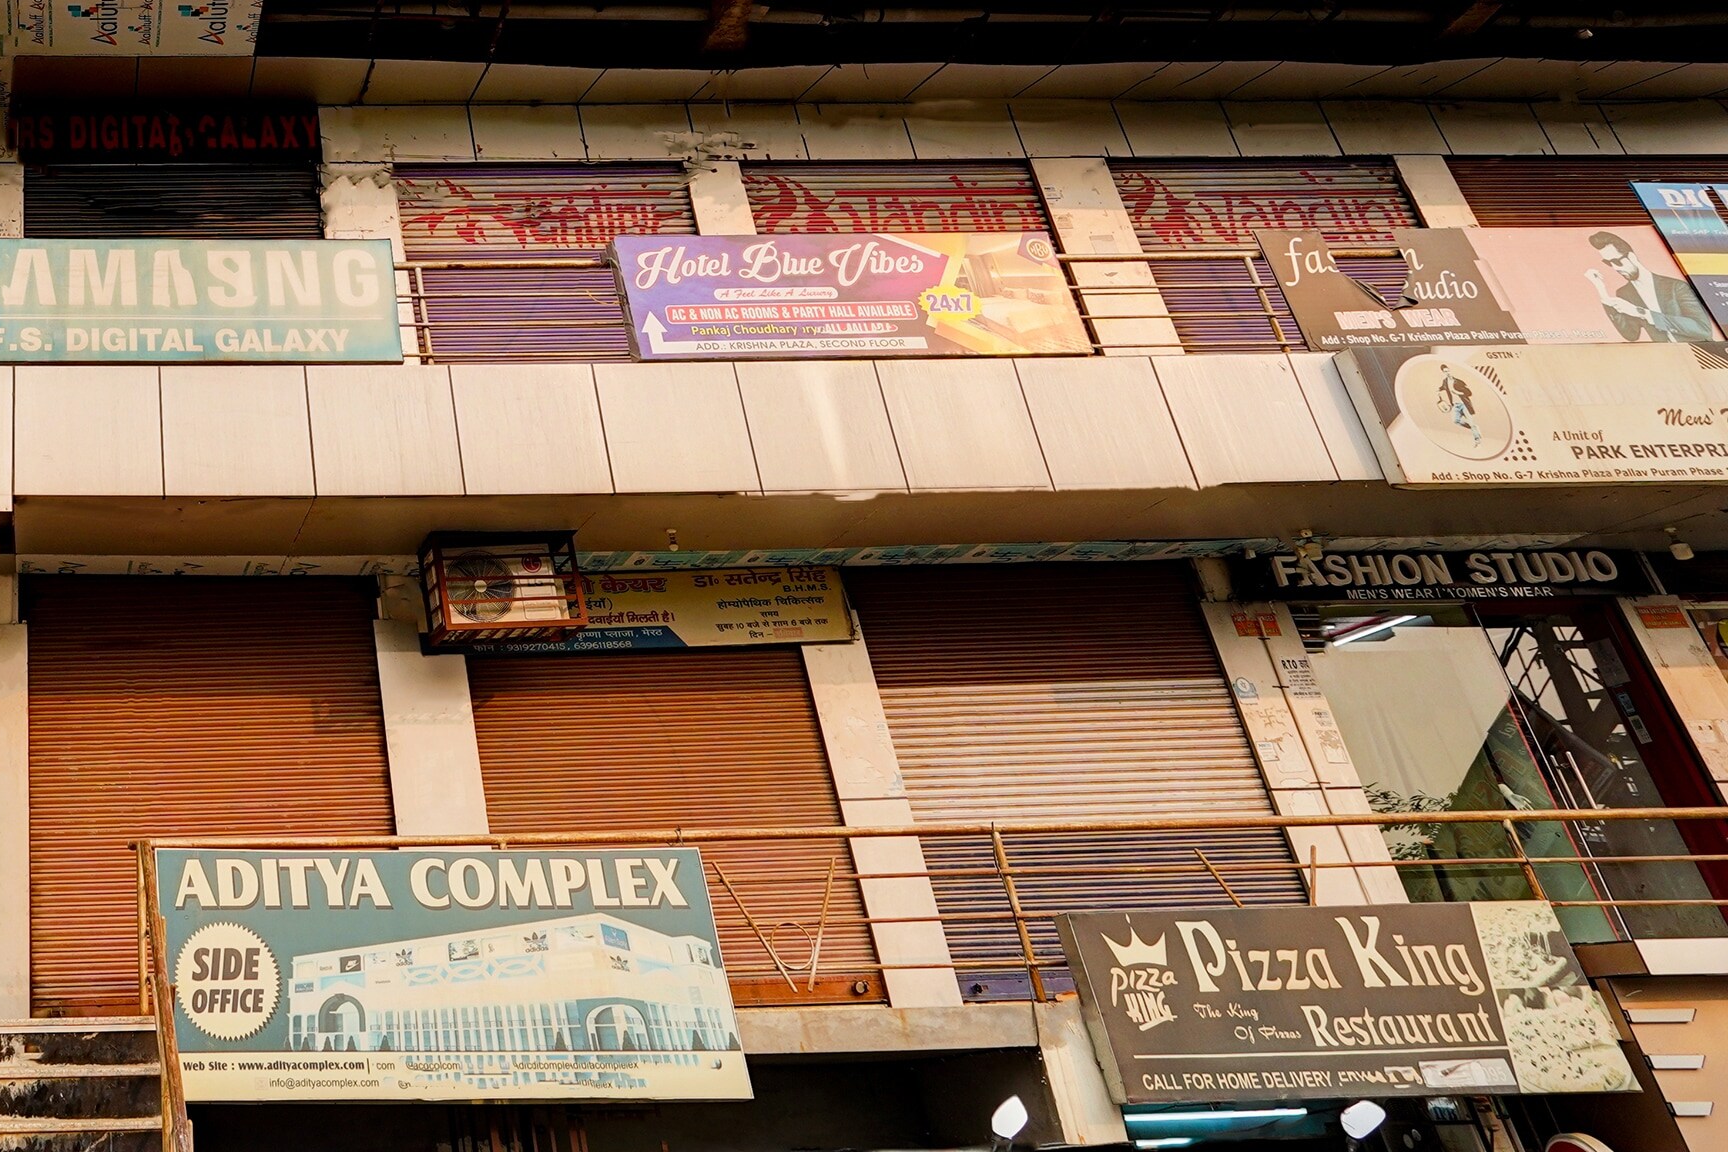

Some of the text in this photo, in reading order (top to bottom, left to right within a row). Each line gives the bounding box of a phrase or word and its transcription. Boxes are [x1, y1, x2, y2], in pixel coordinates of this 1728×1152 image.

[635, 240, 925, 289] Hotel Blue Vibes
[671, 303, 912, 321] AC & NON AC ROOMS & PARTY HALL AVAILABLE
[926, 294, 973, 314] 24x7
[1334, 308, 1461, 330] MEN'S WEAR
[66, 328, 204, 353] DIGITAL
[215, 329, 350, 353] GALAXY
[1486, 351, 1514, 360] GSTIN
[1552, 429, 1604, 443] A Unit of
[1571, 445, 1627, 460] PARK
[1431, 466, 1723, 483] Add Shop No. G-7 Krishna Plaza Pallav Puram Phase
[1272, 550, 1619, 588] FASHION STUDIO
[783, 584, 832, 592] B.H.M.S.
[1346, 588, 1389, 600] MEN'S
[1390, 587, 1434, 600] WEAR
[1511, 585, 1554, 597] WEAR
[626, 611, 659, 623] मिलती
[174, 857, 690, 909] ADITYA COMPLEX
[191, 947, 260, 982] SIDE
[1175, 915, 1487, 997] Pizza King
[191, 987, 265, 1015] OFFICE
[1193, 1001, 1259, 1022] The King
[1234, 1024, 1303, 1042] Of Pizzas
[1300, 1002, 1499, 1049] Restaurant
[182, 1060, 365, 1074] Web Site www.adityacomplex.com
[268, 1076, 380, 1090] info@adityacomplex.com
[1142, 1072, 1183, 1091] CALL
[1184, 1071, 1215, 1091] FOR
[1216, 1071, 1264, 1090] HOME
[1266, 1069, 1333, 1089] DELIVERY
